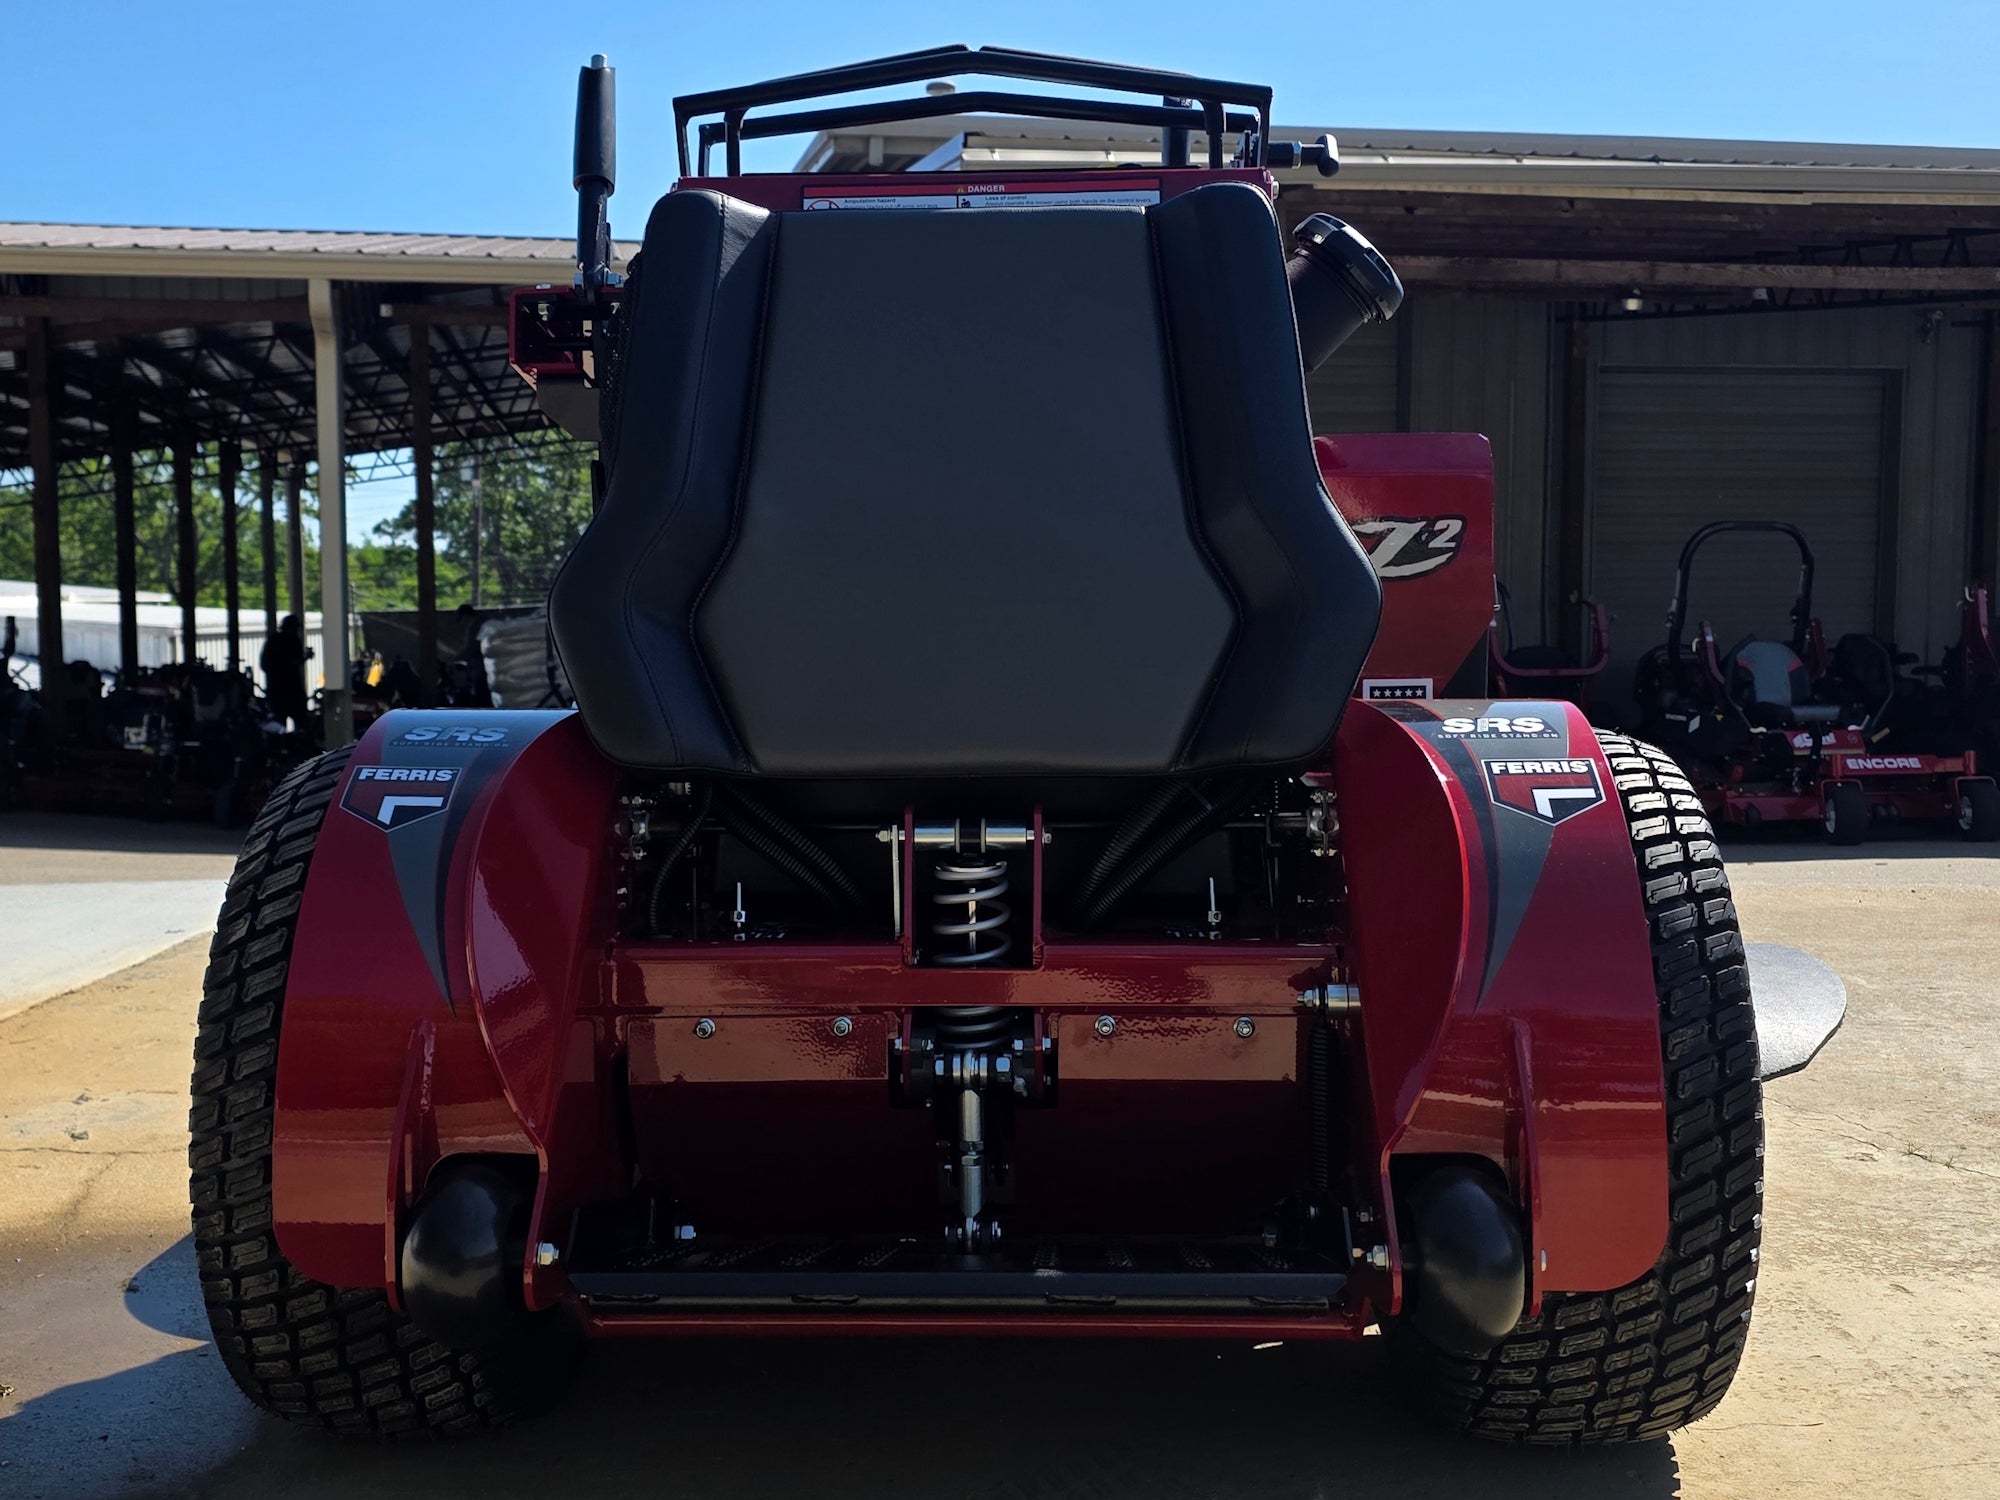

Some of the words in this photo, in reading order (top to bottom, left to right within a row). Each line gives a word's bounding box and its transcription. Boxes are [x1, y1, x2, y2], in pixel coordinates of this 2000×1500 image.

[967, 185, 1005, 193] DANGER
[1442, 717, 1545, 733] SRS
[404, 726, 509, 742] SRS
[1490, 760, 1589, 775] FERRIS
[1846, 757, 1922, 770] ENCORE
[358, 768, 453, 782] FERRIS
